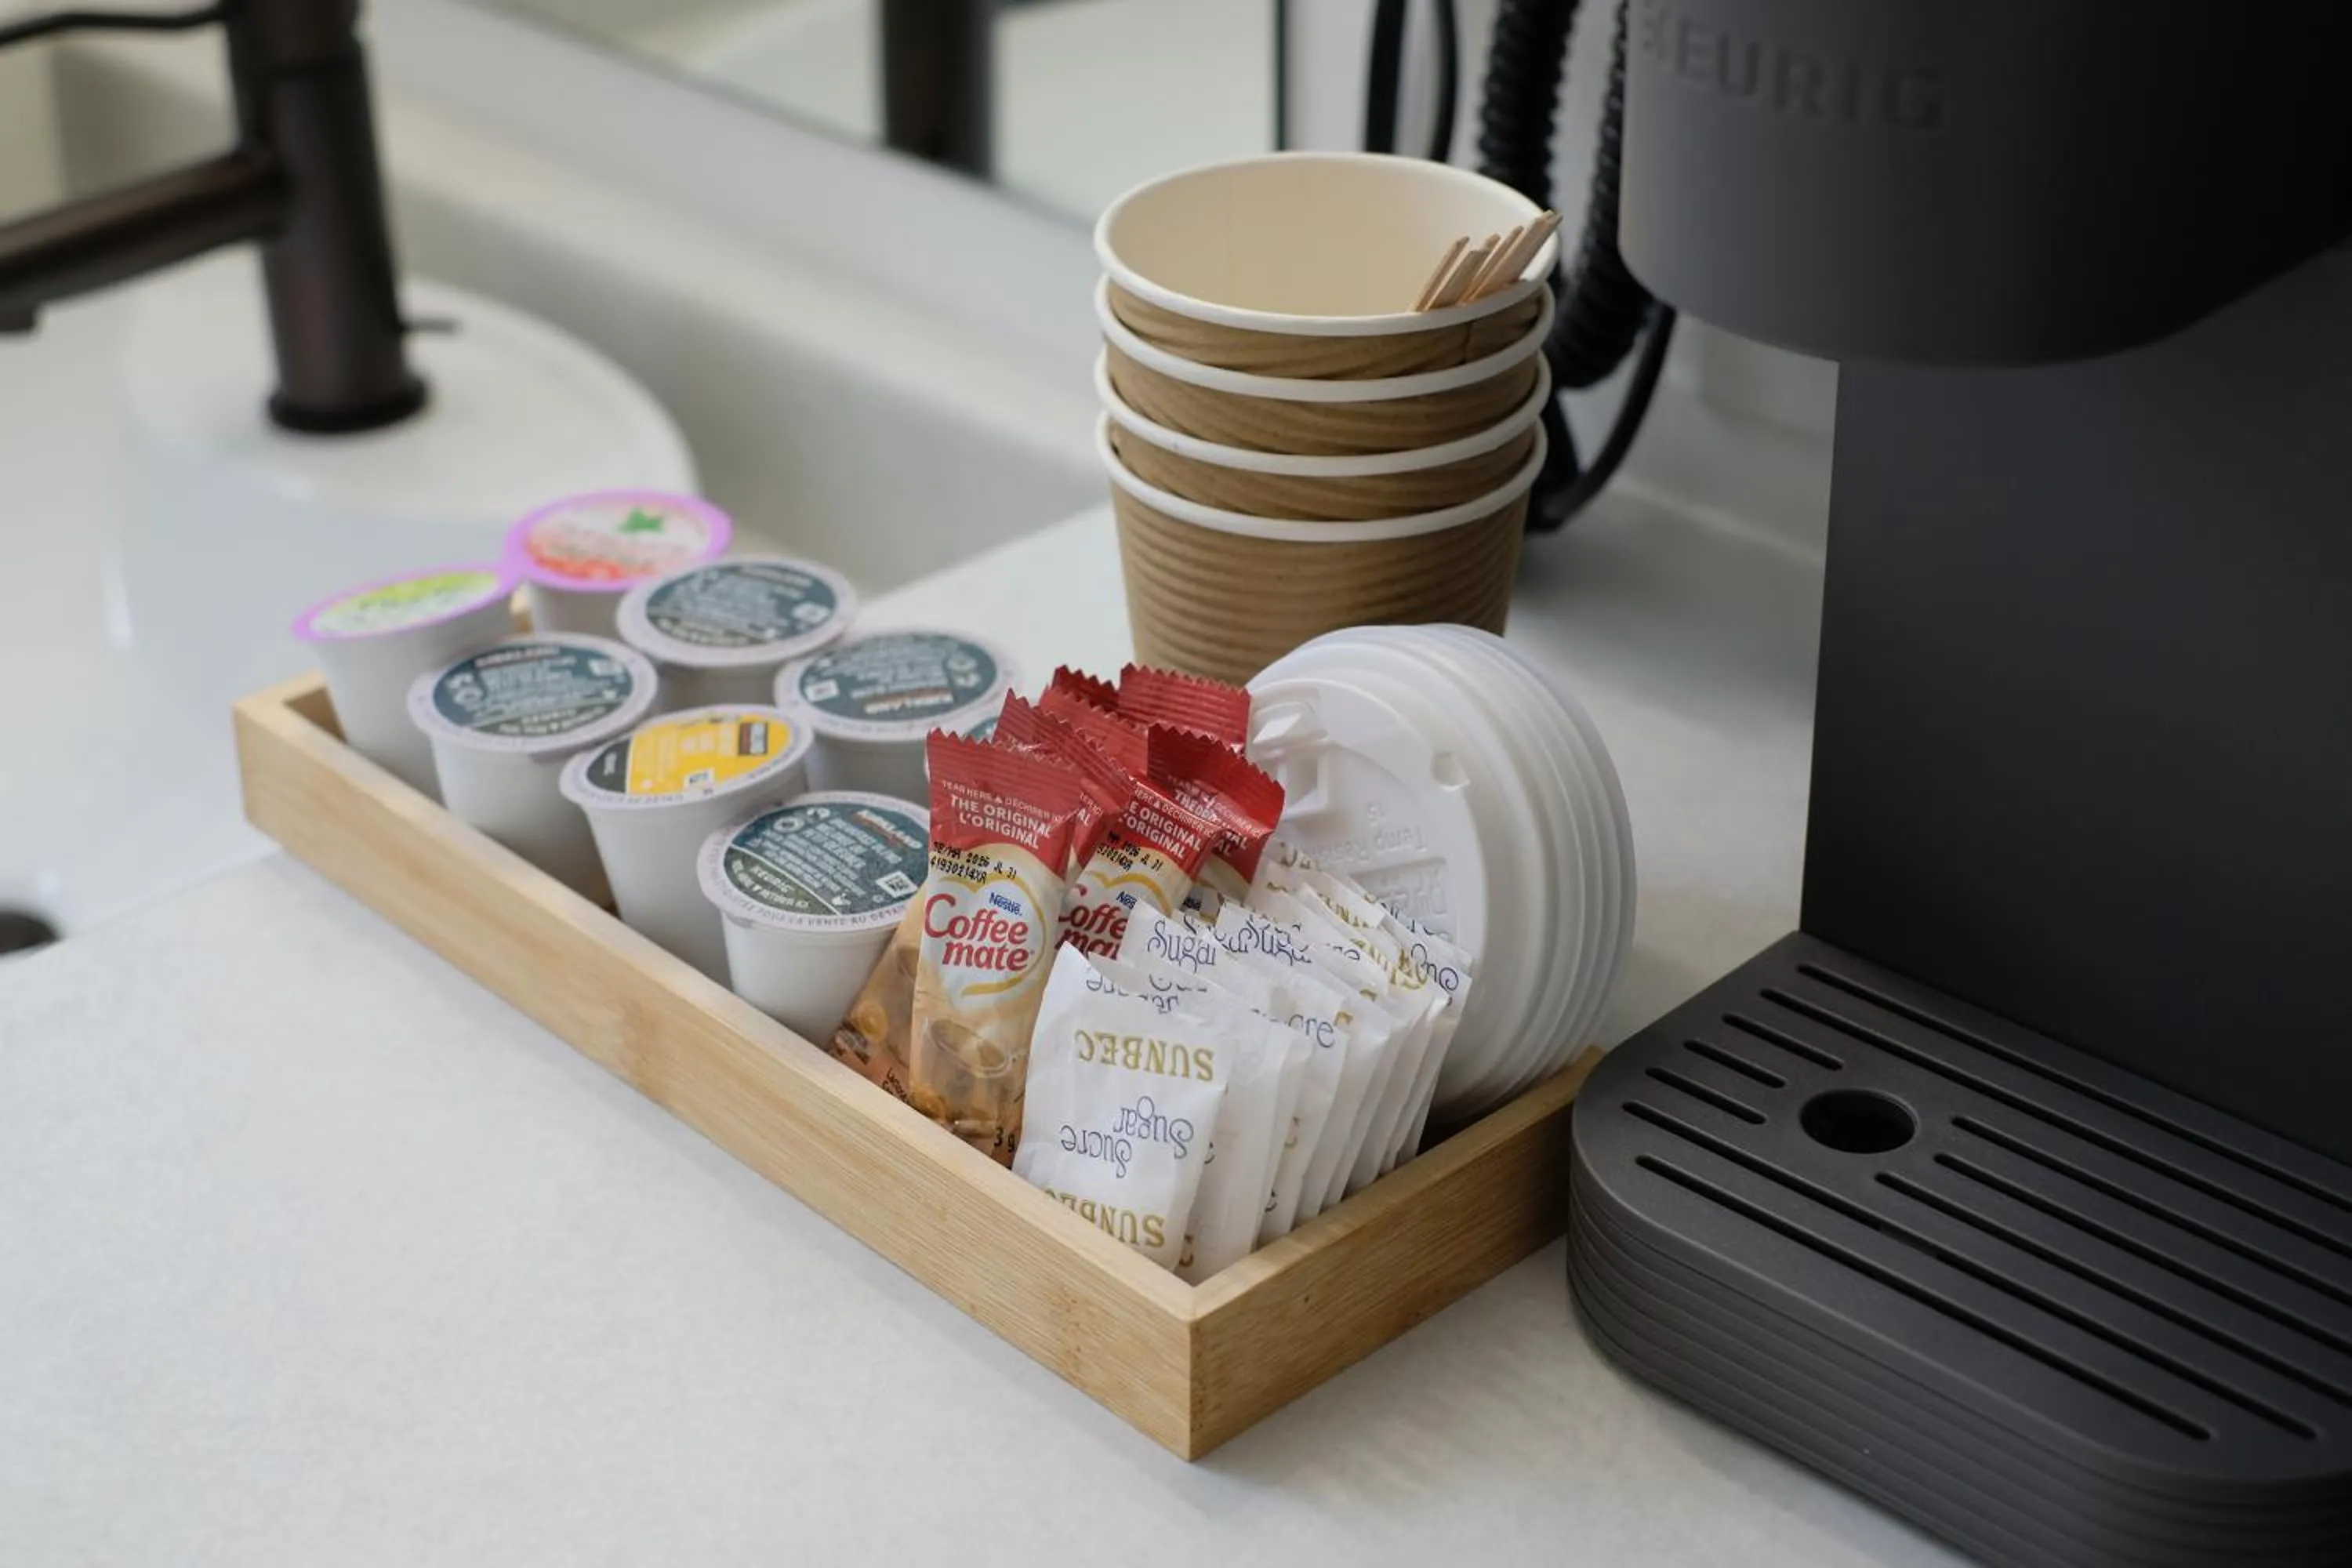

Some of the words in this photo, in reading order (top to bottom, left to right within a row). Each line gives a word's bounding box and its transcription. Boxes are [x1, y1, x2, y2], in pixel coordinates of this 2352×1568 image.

[950, 793, 981, 814] THE
[983, 803, 1053, 839] ORIGINAL
[959, 811, 1040, 850] L'ORIGINAL
[1139, 807, 1203, 852] ORIGINAL
[924, 892, 1030, 945] Coffee
[942, 940, 1029, 972] mate
[1074, 1029, 1214, 1082] SUNBEC
[1059, 1124, 1133, 1178] Sucre
[1112, 1095, 1195, 1160] Sugar
